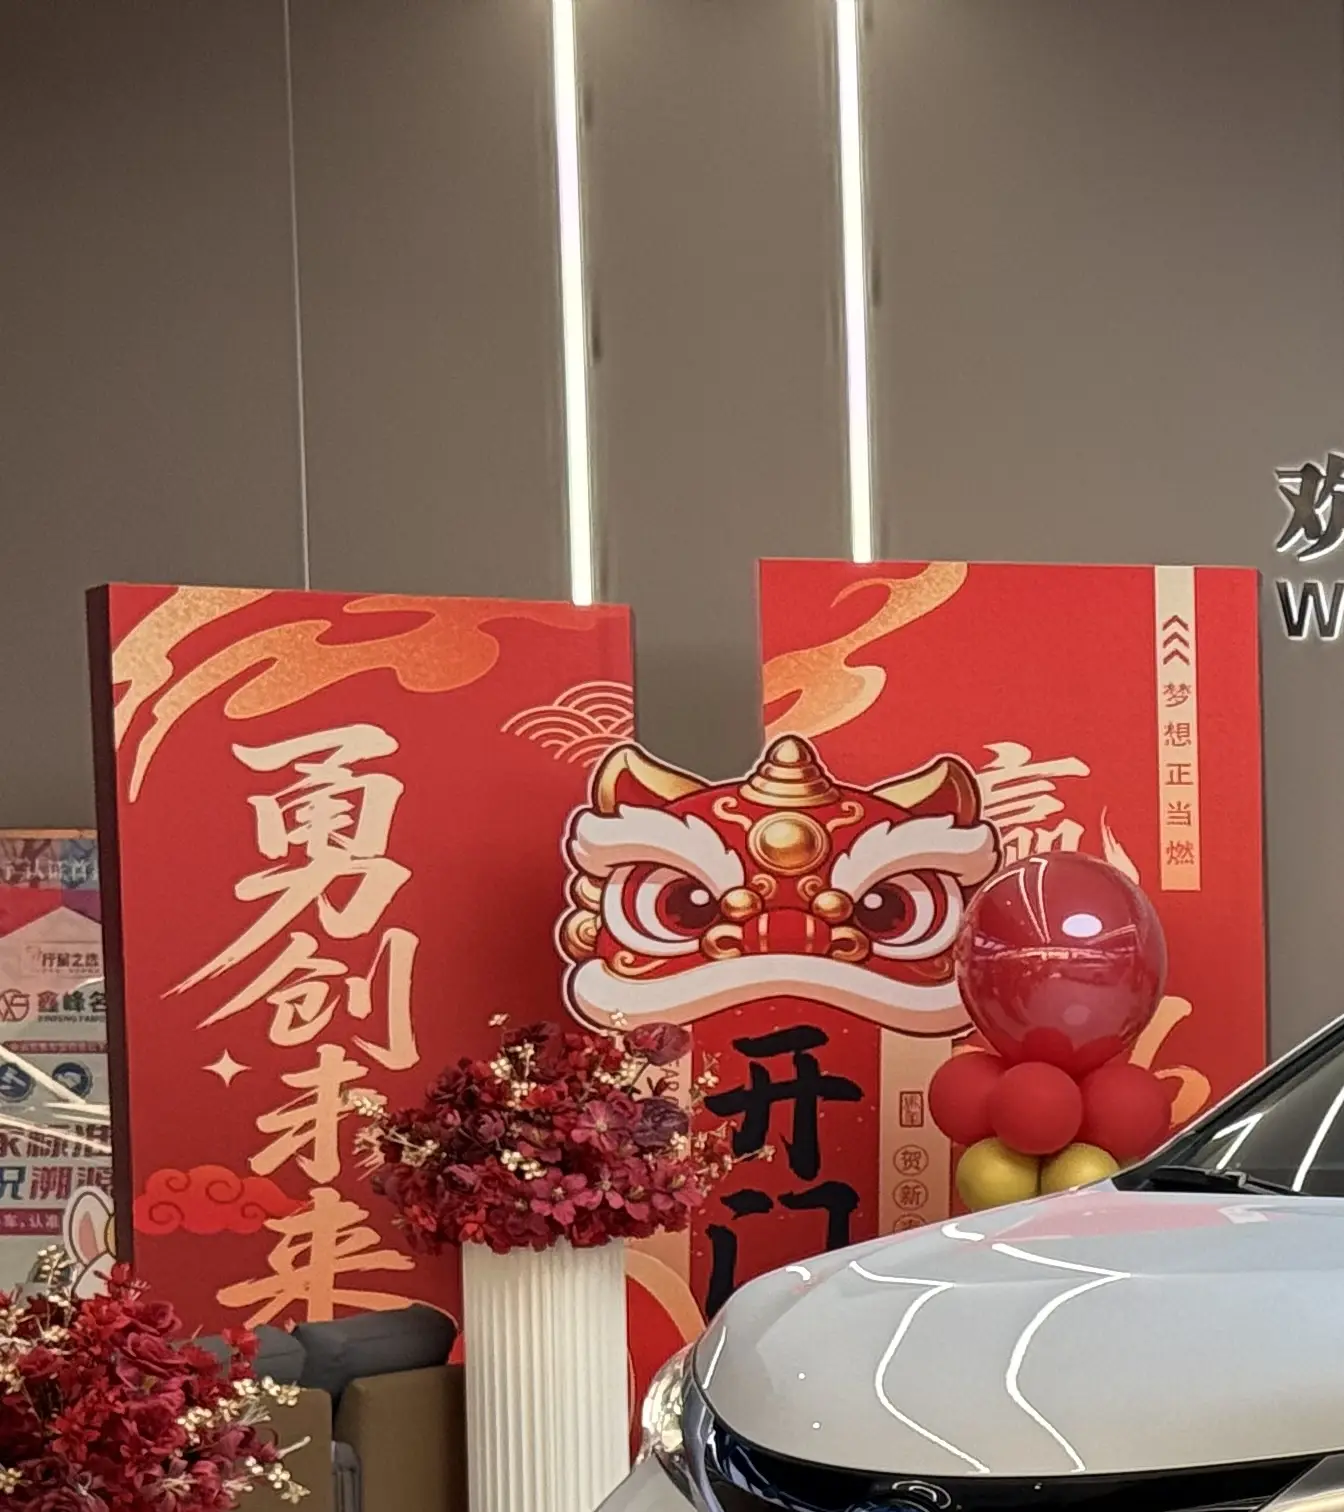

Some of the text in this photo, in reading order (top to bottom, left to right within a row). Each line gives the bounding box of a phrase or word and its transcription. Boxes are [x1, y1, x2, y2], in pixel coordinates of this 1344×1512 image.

[1163, 683, 1196, 866] 梦想正当燃
[161, 723, 420, 1330] 勇创未来
